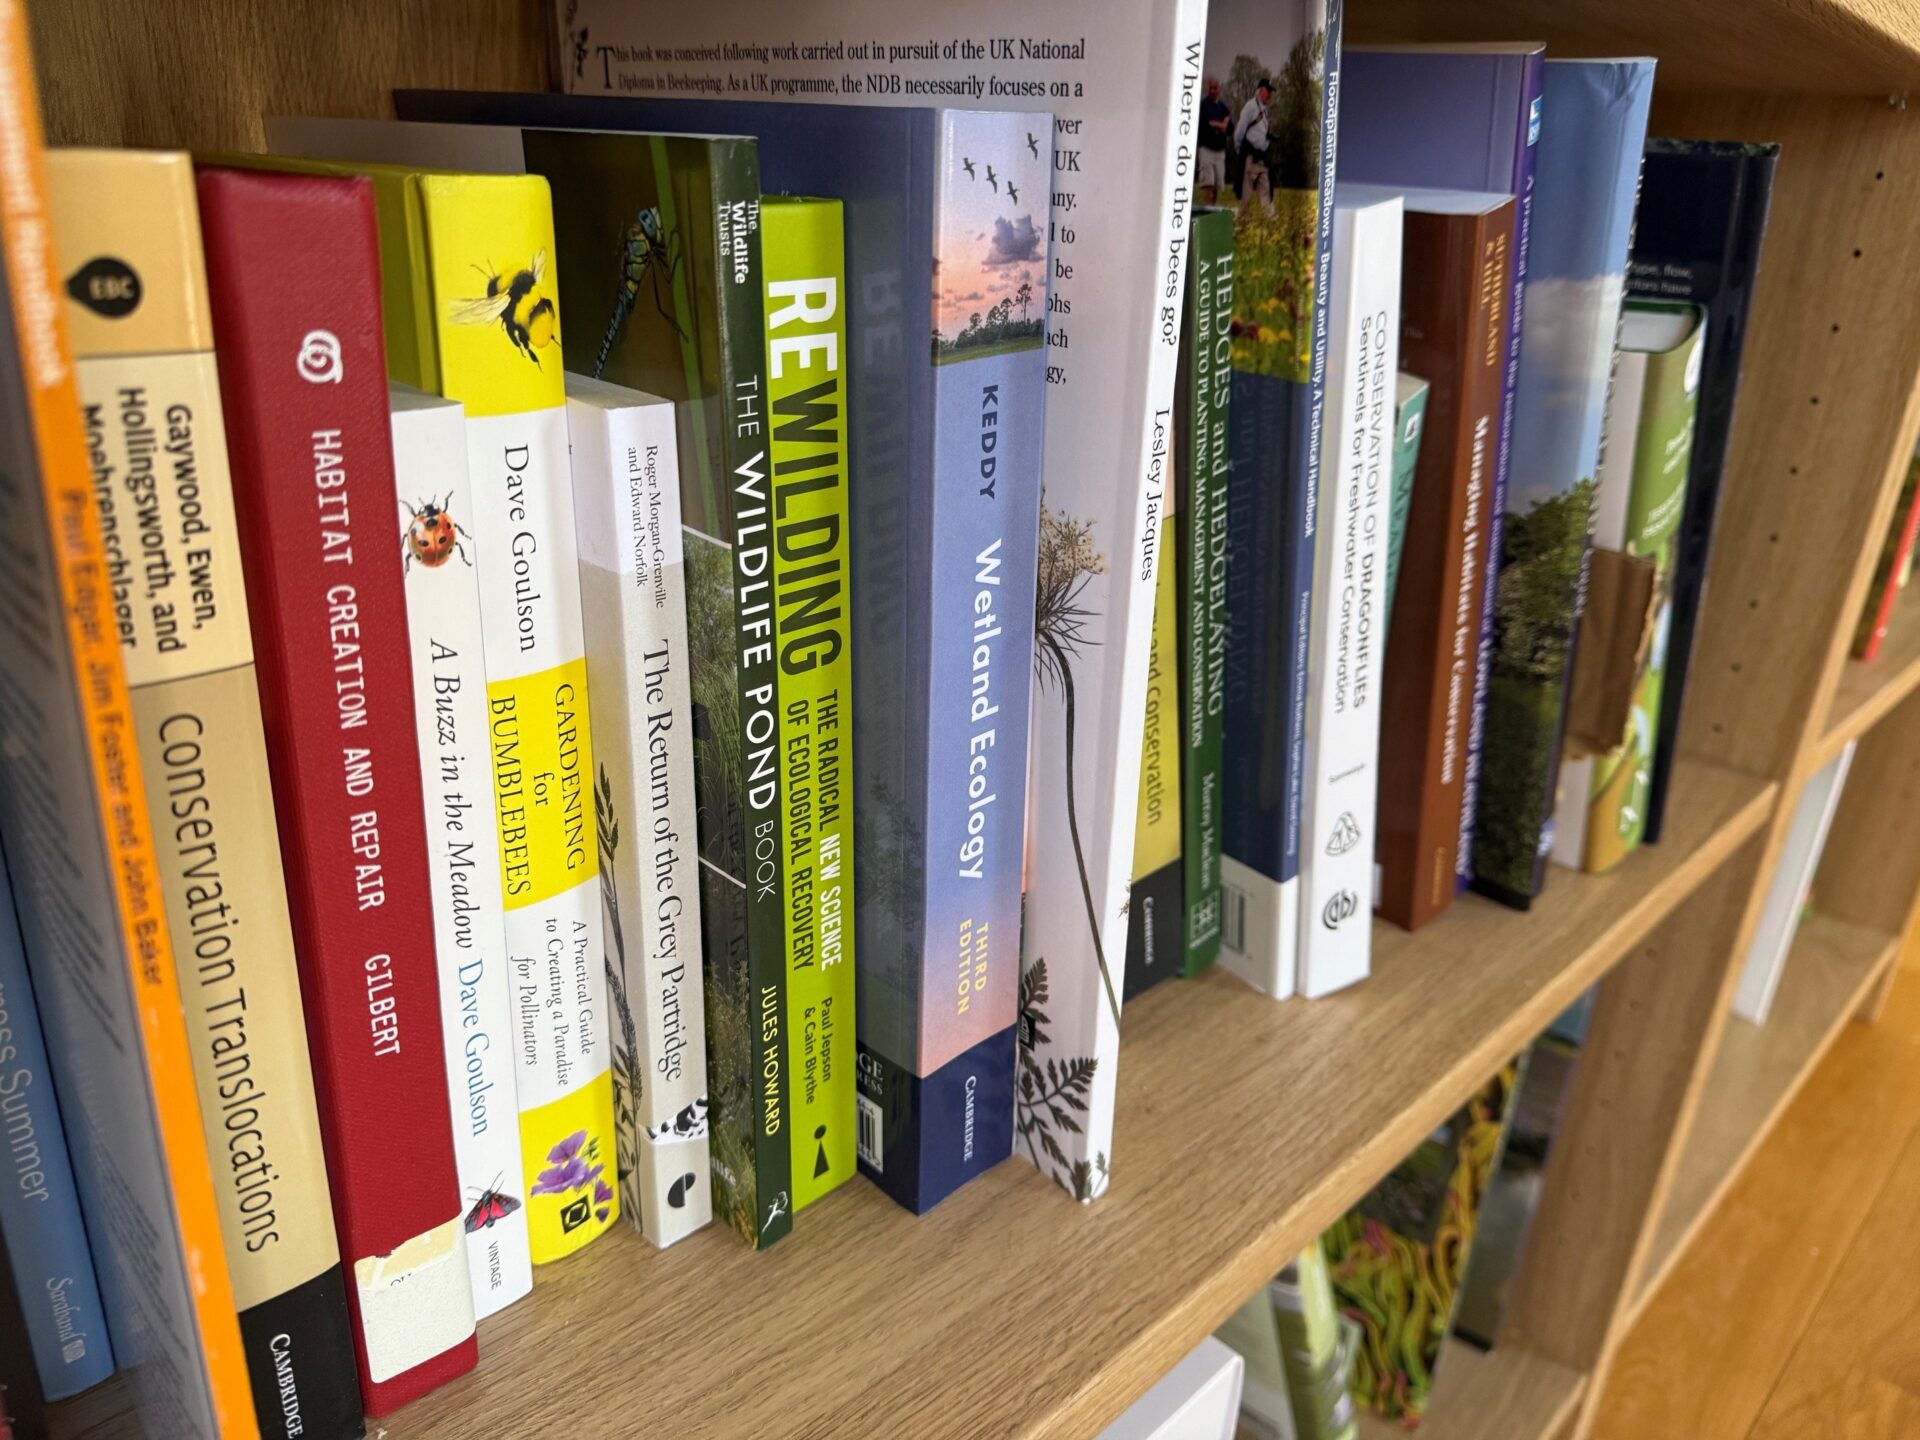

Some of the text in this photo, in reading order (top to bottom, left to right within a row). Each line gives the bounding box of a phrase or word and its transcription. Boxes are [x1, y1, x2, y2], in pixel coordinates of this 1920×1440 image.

[618, 73, 1084, 99] Diploma in Beekeeping. As a UK programme, the NDB necessarily focuses on a
[631, 45, 652, 63] book
[656, 48, 673, 62] was
[674, 44, 722, 62] conceived
[723, 43, 769, 64] following
[772, 42, 799, 61] work
[801, 41, 844, 60] carried
[847, 42, 868, 60] out
[872, 41, 885, 60] in
[889, 40, 939, 63] pursuit
[943, 39, 958, 60] of
[961, 39, 985, 60] the
[989, 39, 1015, 60] UK
[1019, 38, 1085, 60] National
[719, 201, 731, 256] Trusts
[732, 200, 749, 284] Wildlife
[748, 200, 759, 230] The
[1054, 150, 1081, 172] UK
[1061, 224, 1075, 244] to
[1161, 41, 1201, 347] Where do the bees go?
[1056, 257, 1074, 280] be
[1304, 71, 1339, 538] Floodplain Meadows Beauty and Utility. A Technical Handbook
[118, 388, 187, 653] Hollingsworth, and
[165, 404, 216, 629] Gaywood, Ewen,
[504, 443, 541, 653] Dave Goulson
[628, 447, 648, 588] and Edward Norfolk
[644, 445, 668, 609] Roger Morgan-Grenville
[768, 276, 843, 678] REWILDING
[1140, 407, 1170, 582] Lesley Jacques
[1192, 260, 1211, 748] A GUIDE TO PLANTING, MANAGEMENT AND CONSERVATION
[1207, 253, 1233, 716] HEDGES and HEDGELAYING
[1335, 316, 1371, 714] Sentinels for Freshwater Conservation
[1354, 310, 1387, 709] CONSERVATION OF DRAGONFLIES
[733, 374, 776, 904] THE WILDLIFE POND BOOK
[959, 384, 1002, 880] KEDDY Wetland Ecology
[1441, 415, 1490, 785] Managing Habitats for Conservation
[311, 428, 401, 1057] HABITAT CREATION AND REPAIR GILBERT
[491, 694, 531, 896] BUMBLEBEES
[533, 772, 555, 807] for
[555, 683, 586, 871] GARDENING
[430, 637, 494, 1138] A Buzz in the Meadow Dave Goulson
[643, 638, 688, 1083] The Return of the Grey Partridge
[786, 699, 814, 972] OF ECOLOGICAL RECOVERY
[817, 688, 842, 972] THE RADICAL NEW SCIENCE
[159, 713, 279, 1254] Conservation Translocations
[510, 956, 541, 1066] for Pollinators
[545, 918, 570, 1087] to Creating a Paradise
[572, 919, 596, 1055] A Practical Guide
[821, 996, 833, 1082] Paul Jepson
[957, 917, 972, 1016] EDITION
[974, 921, 990, 992] THIRD
[0, 1068, 50, 1202] Summer
[761, 984, 781, 1137] JULES HOWARD
[803, 1006, 818, 1105] & Cain Blythe
[963, 1074, 977, 1164] CAMBRIDGE
[47, 1276, 88, 1342] Saraband
[487, 1240, 503, 1290] VINTAGE
[270, 1333, 304, 1440] CAMBRIDGE
